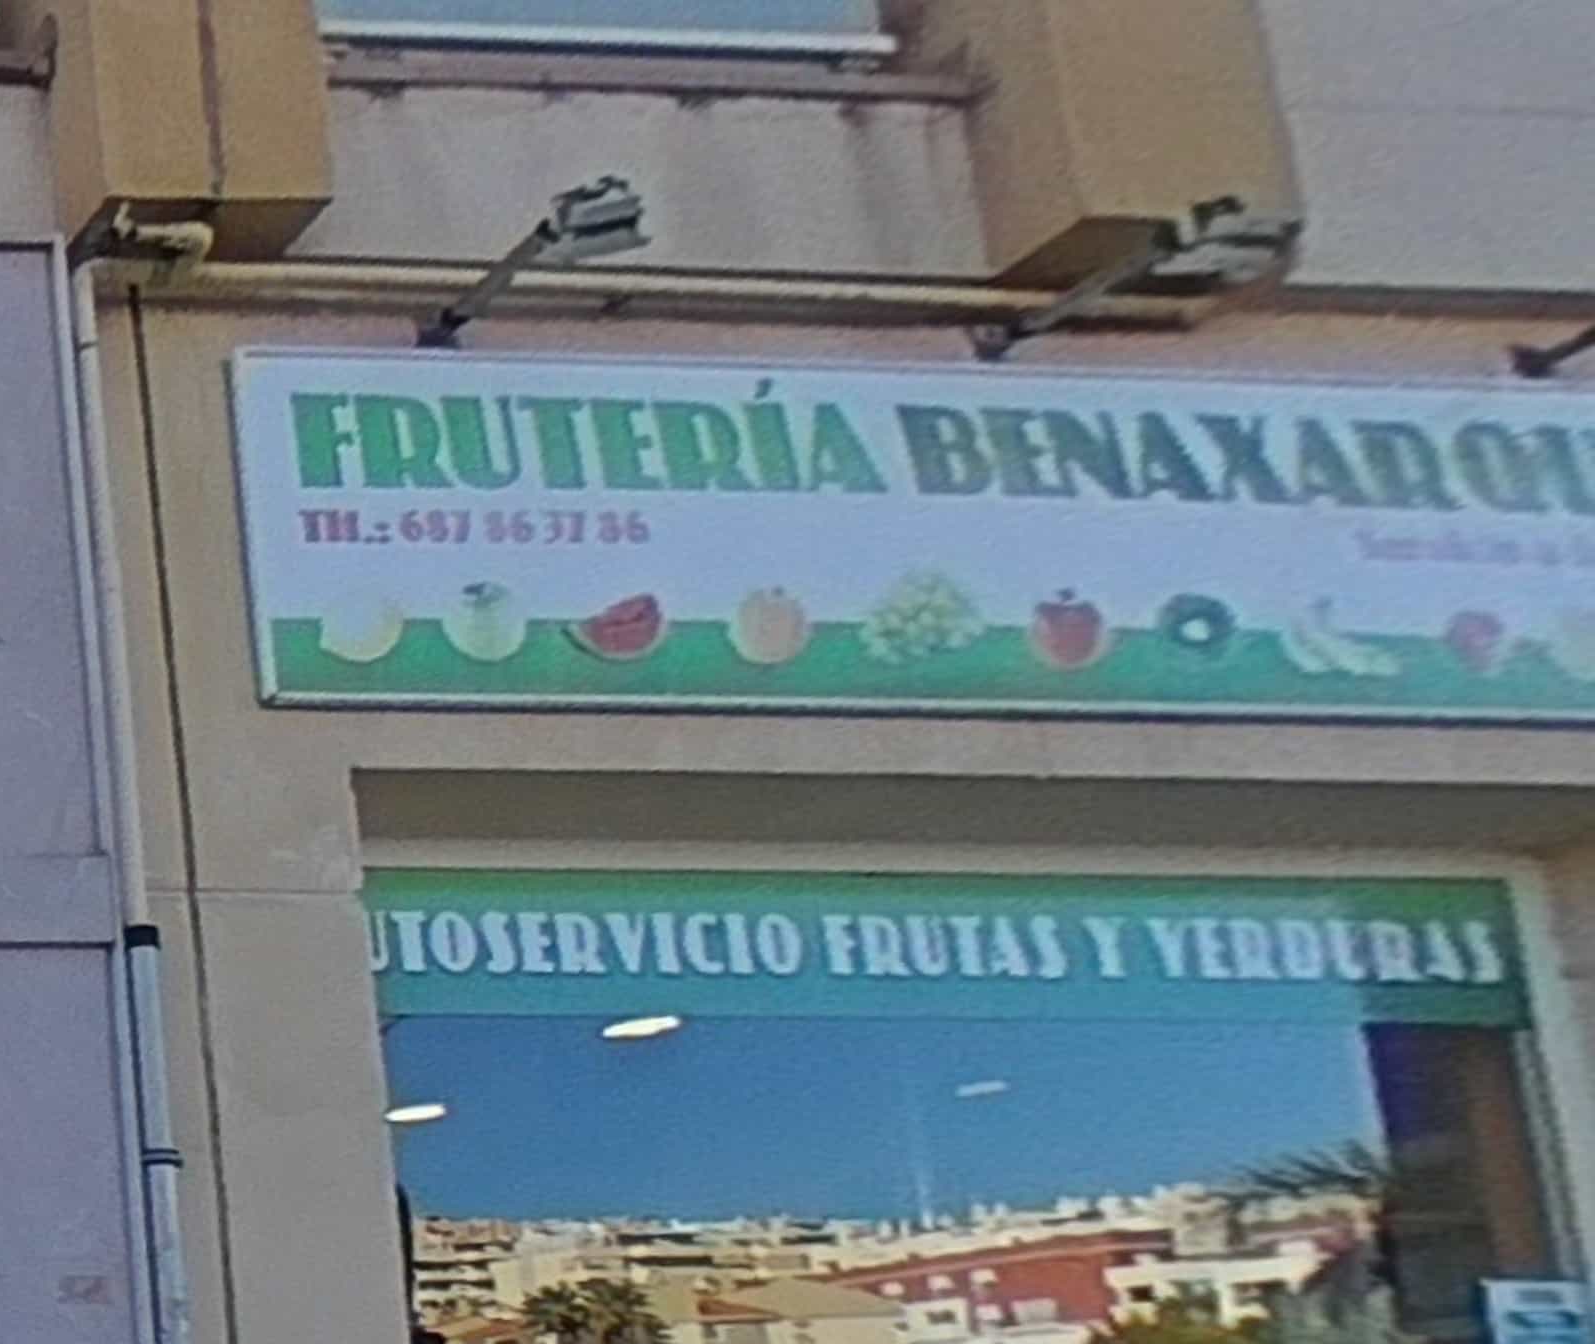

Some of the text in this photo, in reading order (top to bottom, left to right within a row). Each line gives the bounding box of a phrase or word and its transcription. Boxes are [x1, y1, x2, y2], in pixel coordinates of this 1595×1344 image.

[290, 378, 887, 493] FRUTERÍA
[399, 509, 470, 544] 687
[821, 914, 1067, 979] FRUTAS
[1083, 917, 1127, 978] Y
[1148, 917, 1505, 983] VERDURAS
